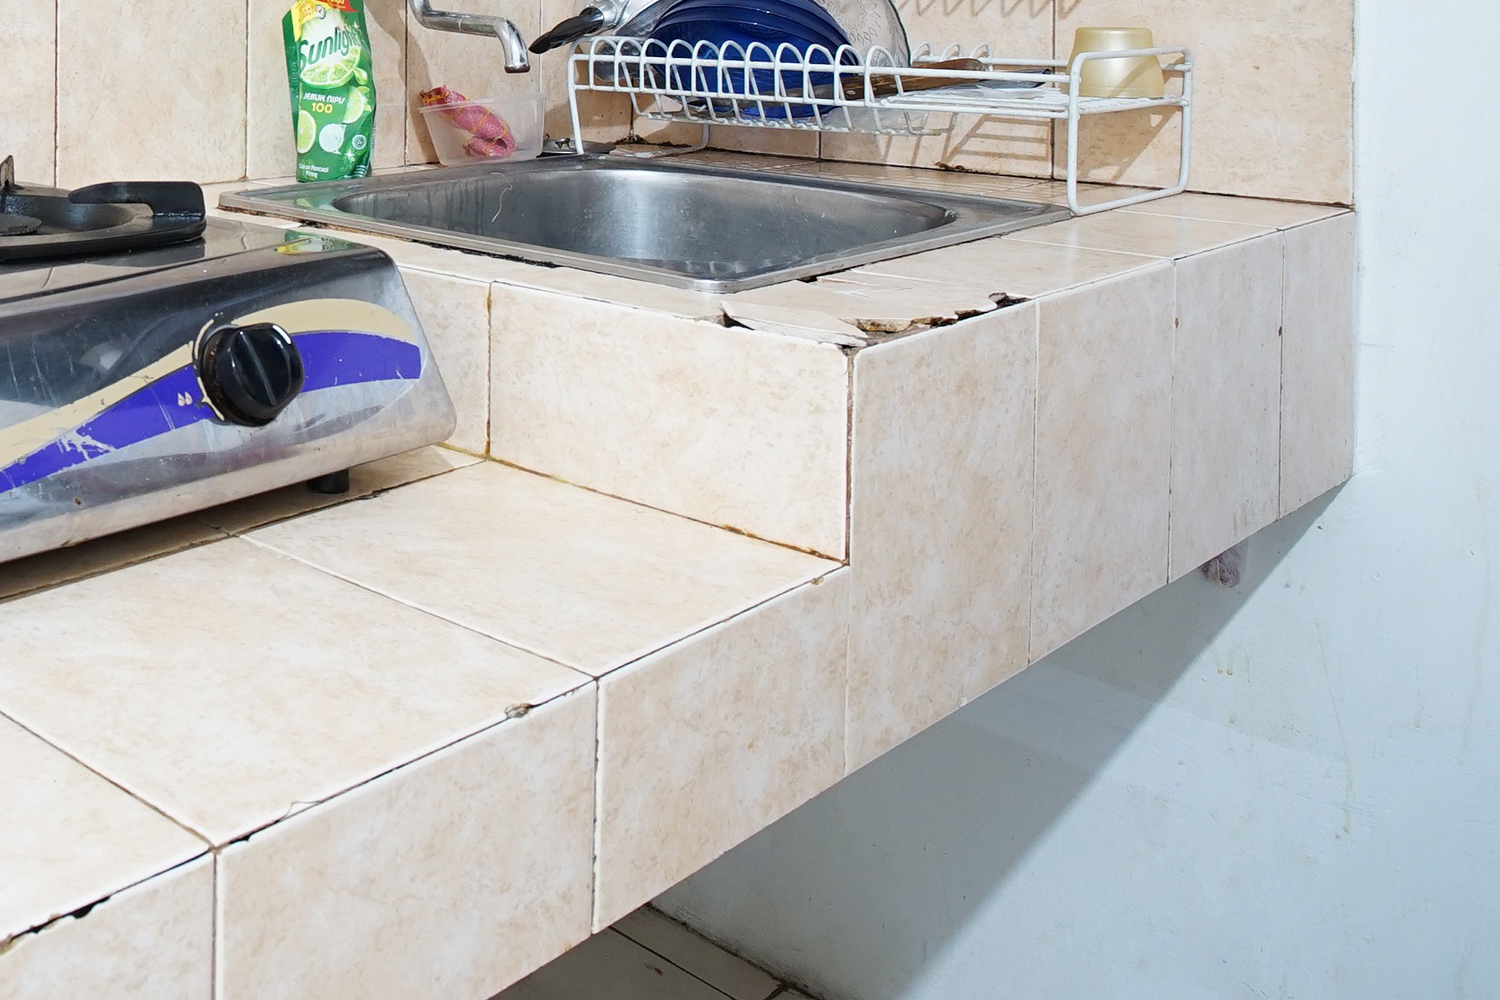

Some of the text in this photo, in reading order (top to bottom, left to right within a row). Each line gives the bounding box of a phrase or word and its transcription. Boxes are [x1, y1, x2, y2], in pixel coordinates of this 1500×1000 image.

[299, 24, 360, 71] Sunlight
[303, 92, 326, 102] JERUK
[311, 102, 333, 114] 100
